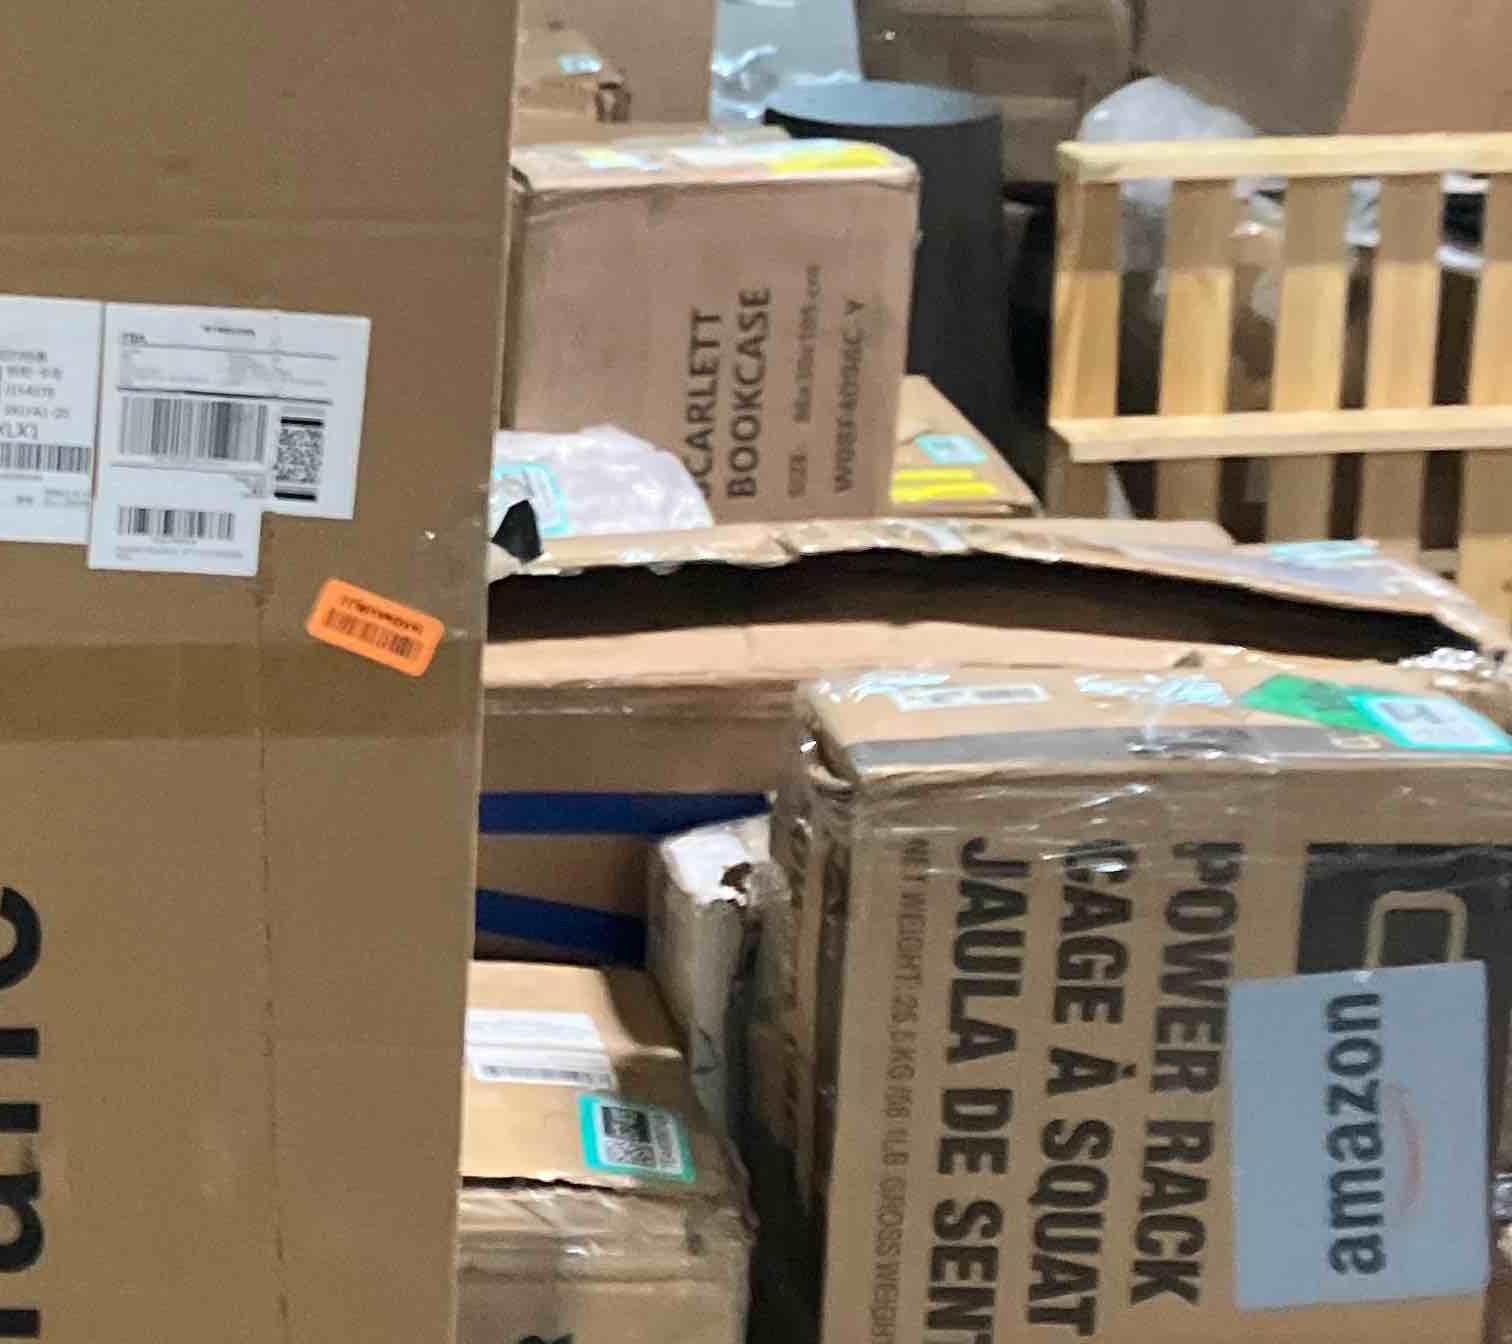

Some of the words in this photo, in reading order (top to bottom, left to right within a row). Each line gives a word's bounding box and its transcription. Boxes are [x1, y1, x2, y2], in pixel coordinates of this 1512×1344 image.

[728, 287, 771, 499] BOOKCASE
[947, 836, 1032, 1065] JAULA
[1053, 838, 1138, 1025] CAGE
[1150, 841, 1245, 1094] POWER
[937, 1088, 1014, 1175] DE
[1027, 1119, 1115, 1338] SQUAT
[1130, 1119, 1215, 1307] RACK
[1326, 992, 1387, 1276] amazon
